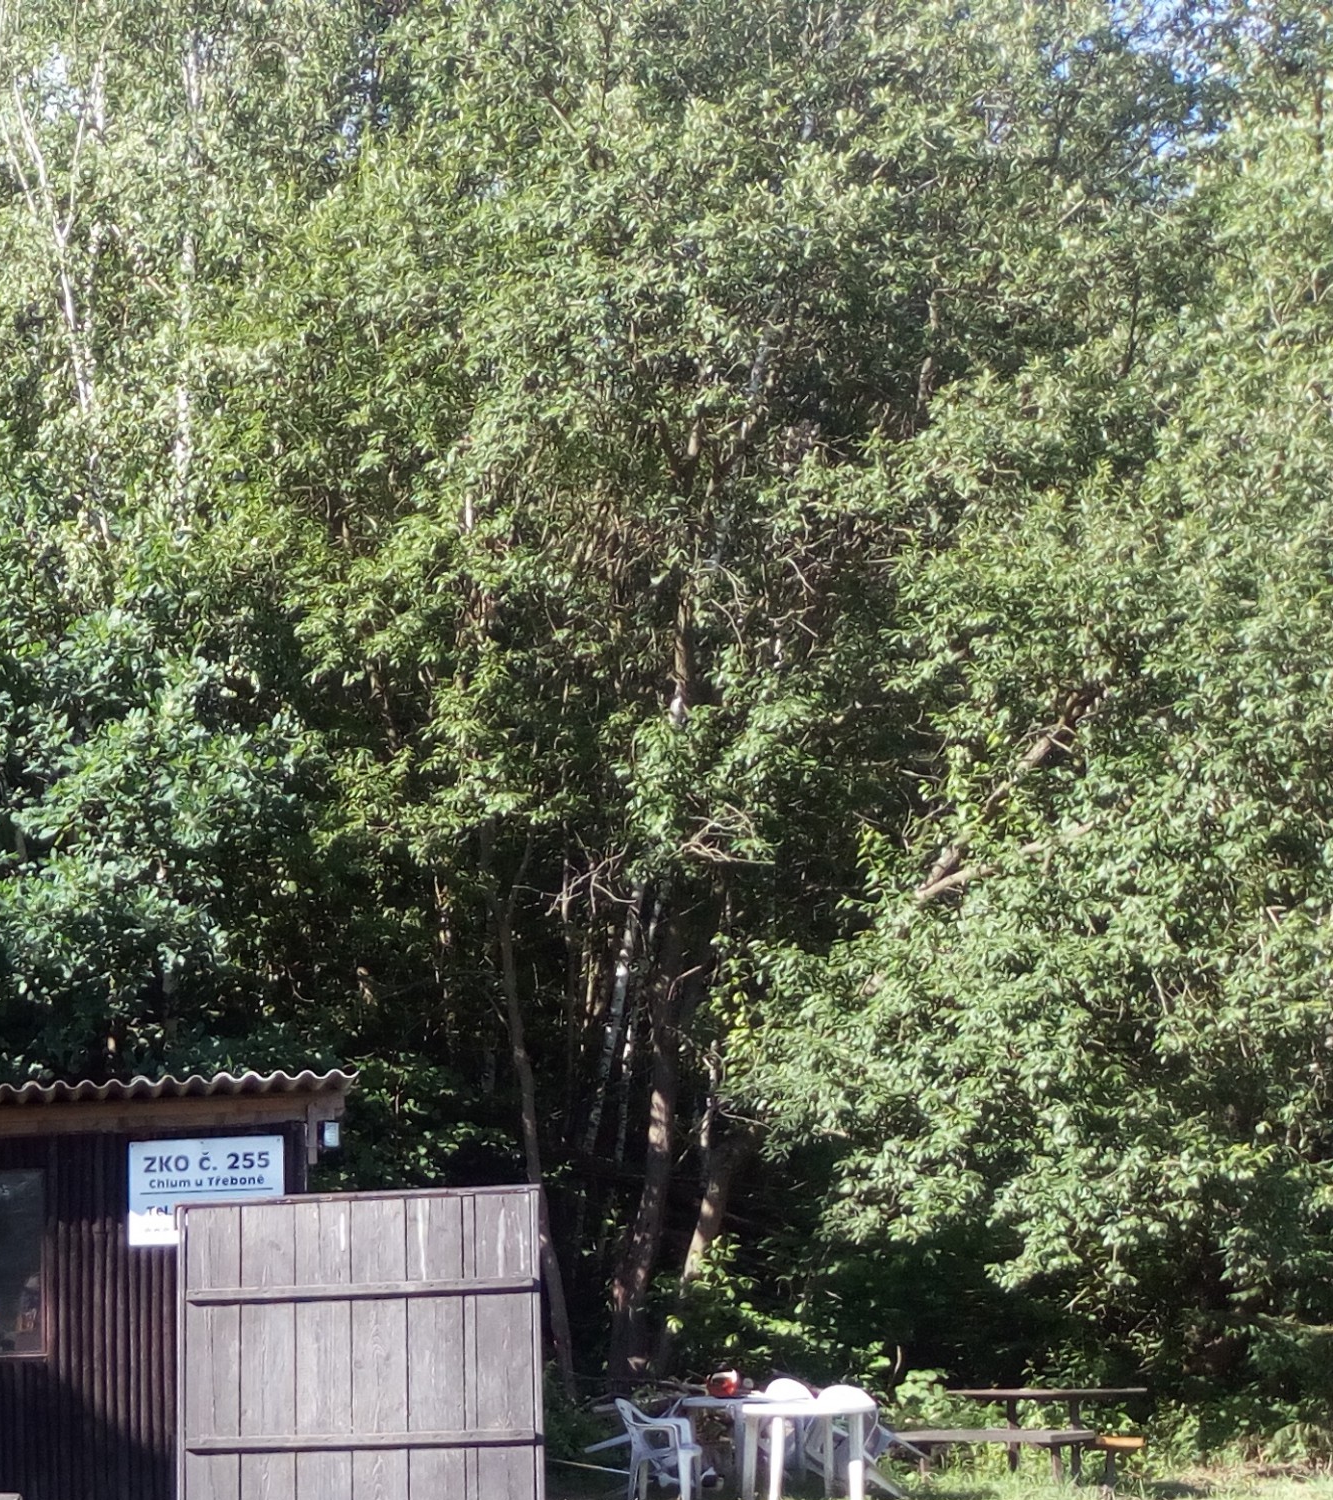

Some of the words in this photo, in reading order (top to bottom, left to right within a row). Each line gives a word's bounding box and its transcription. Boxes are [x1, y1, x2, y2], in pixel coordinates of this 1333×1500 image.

[144, 1155, 190, 1173] ZKO
[199, 1152, 218, 1171] č.
[227, 1151, 270, 1170] 255
[149, 1178, 191, 1189] Chlum
[195, 1178, 203, 1187] u
[207, 1174, 265, 1187] Třeboně
